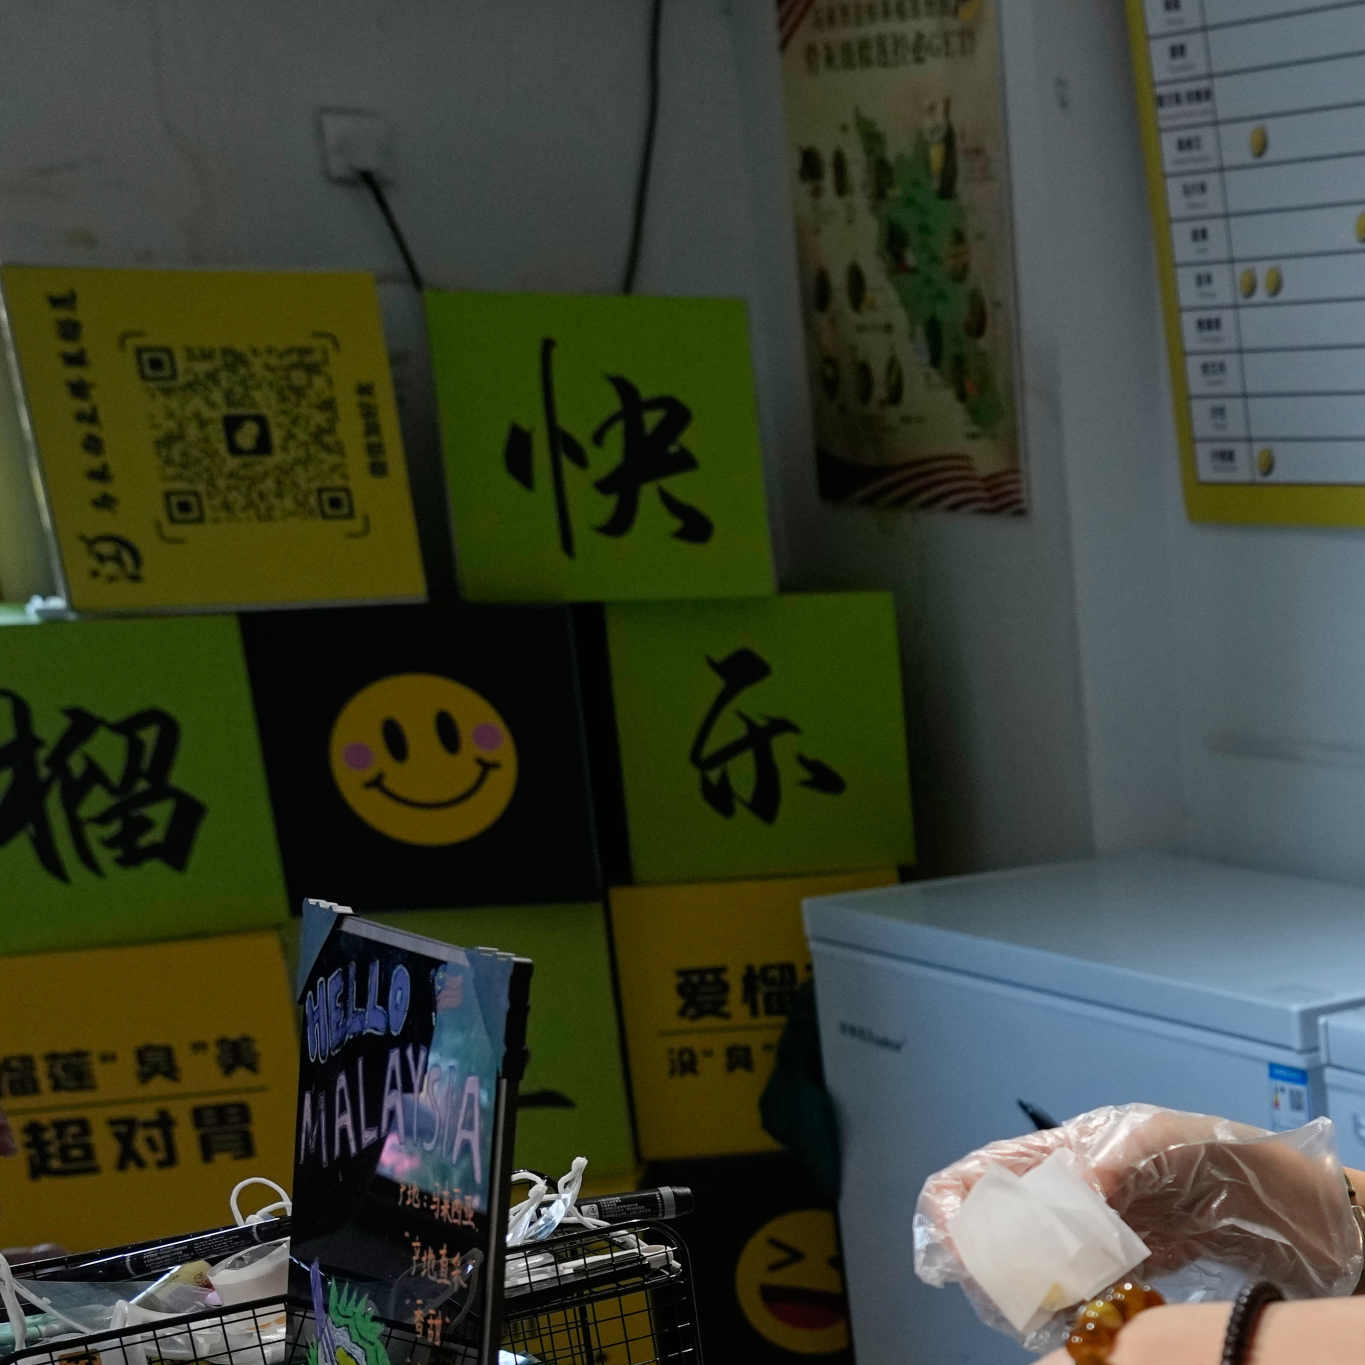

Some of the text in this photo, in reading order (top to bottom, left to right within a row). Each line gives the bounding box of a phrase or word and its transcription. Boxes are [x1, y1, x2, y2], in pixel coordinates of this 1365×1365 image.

[503, 337, 714, 560] 快
[0, 688, 208, 884] 榴
[688, 647, 848, 827] 乐
[305, 959, 411, 1064] HELLO
[675, 961, 812, 1021] 爱榴
[22, 1102, 258, 1182] 超对胃
[299, 1042, 482, 1182] MALAYSIA
